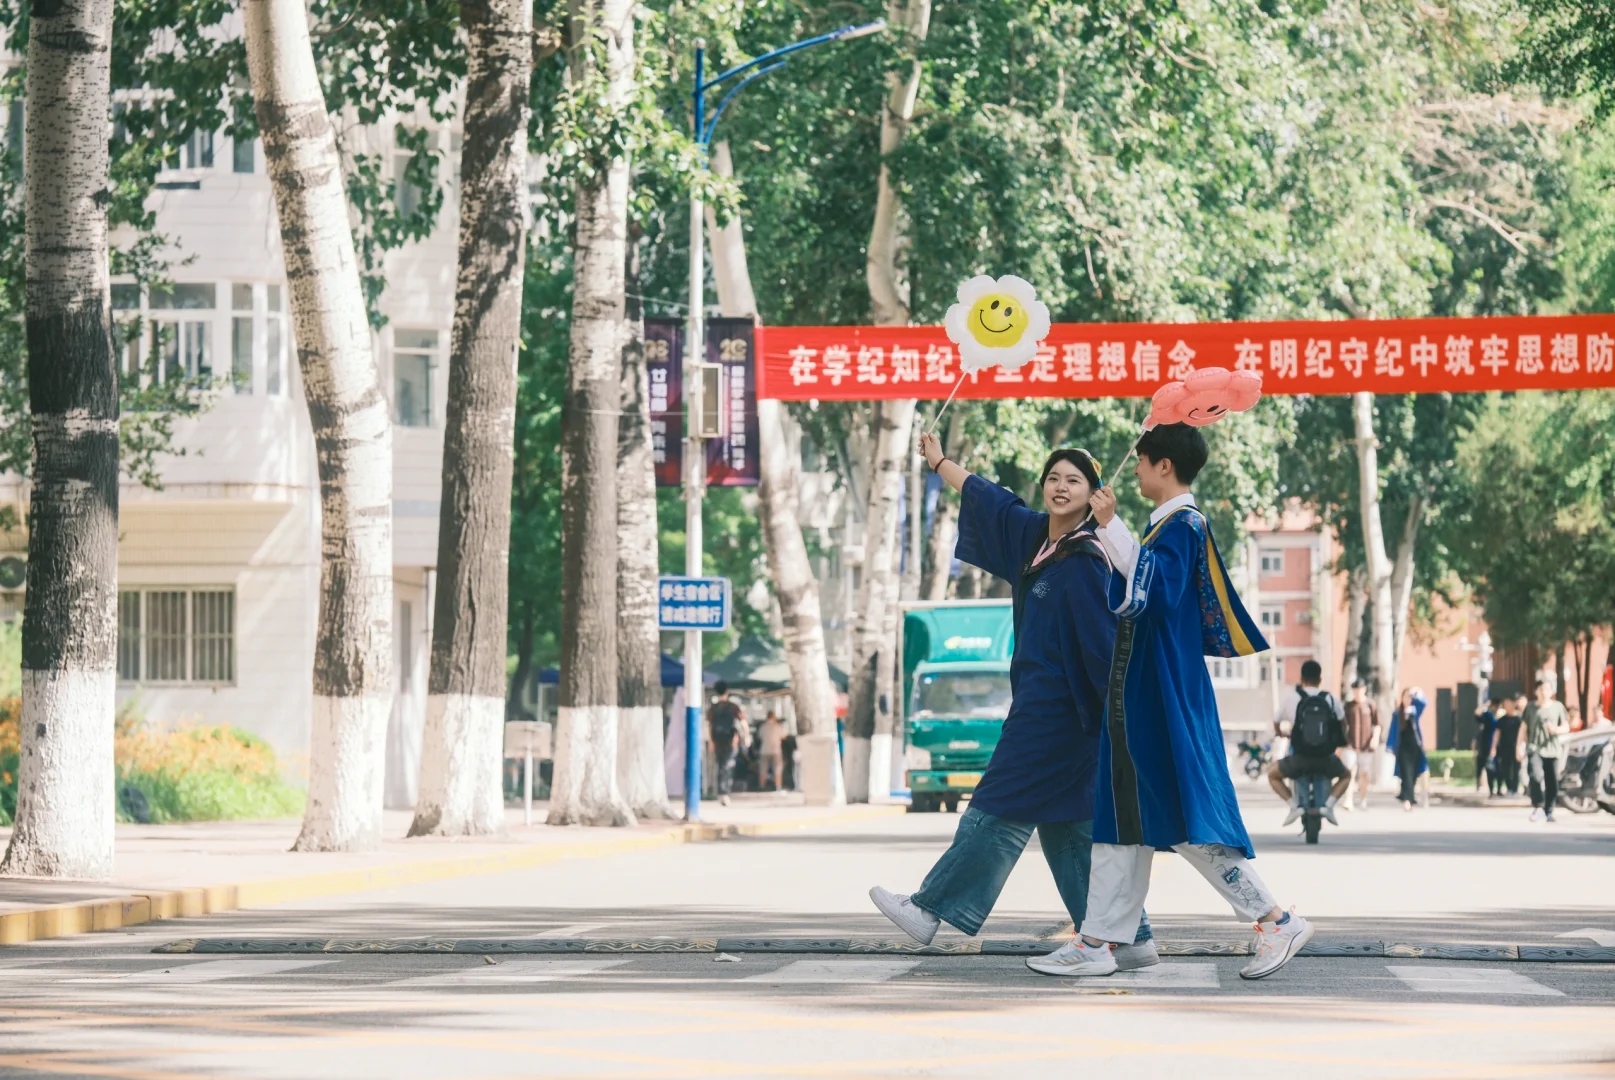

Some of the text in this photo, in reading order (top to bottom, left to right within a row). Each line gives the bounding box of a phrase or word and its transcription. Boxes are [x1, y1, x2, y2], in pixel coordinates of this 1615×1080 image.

[788, 338, 1197, 386] 在学纪知纪定理想信念
[1234, 332, 1615, 380] 在明纪守纪中筑牢思想防
